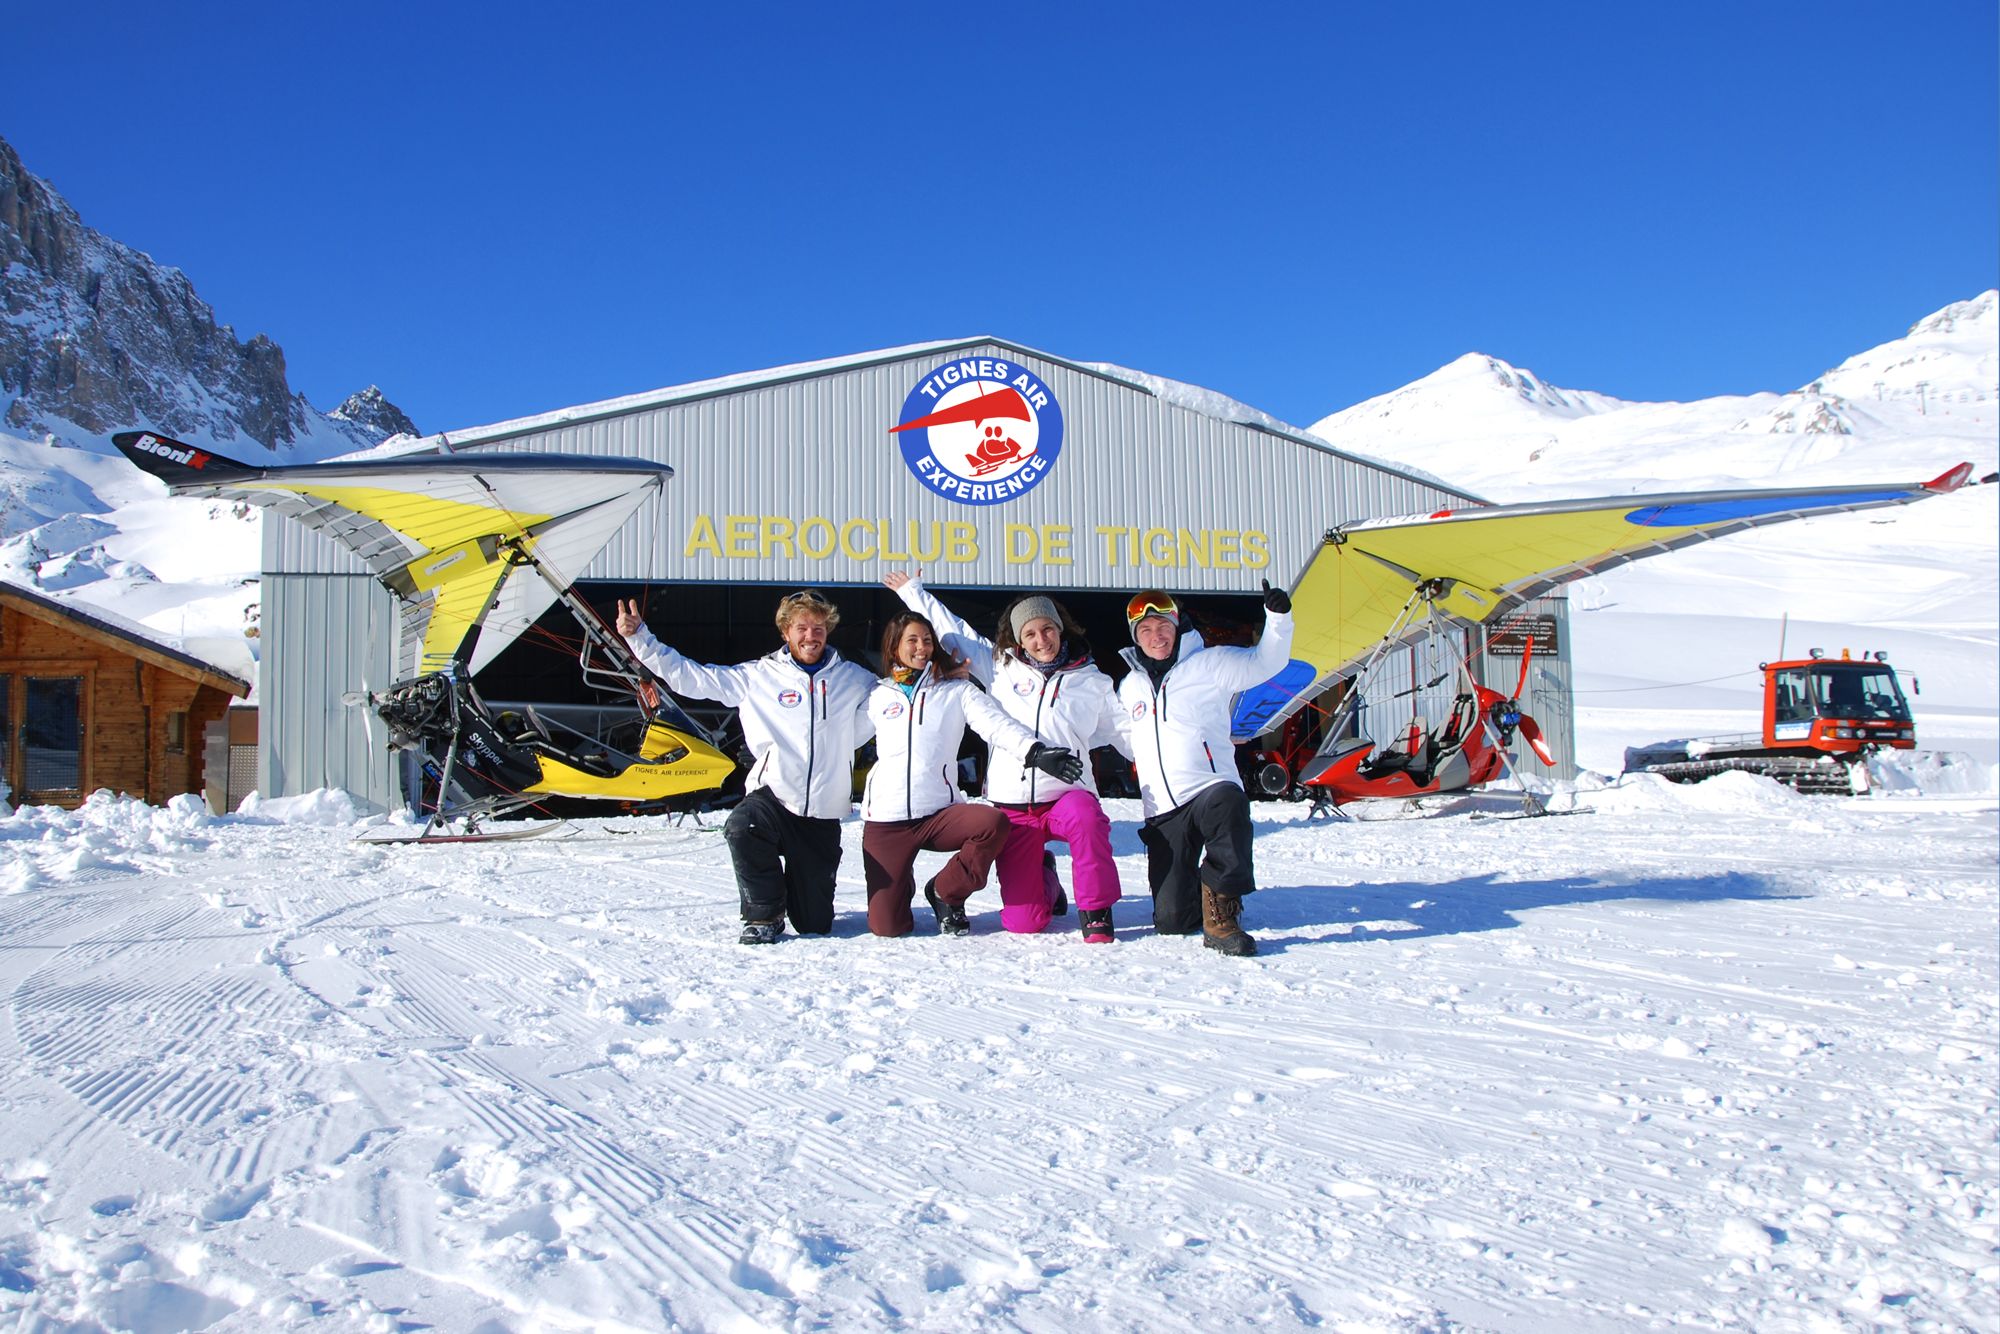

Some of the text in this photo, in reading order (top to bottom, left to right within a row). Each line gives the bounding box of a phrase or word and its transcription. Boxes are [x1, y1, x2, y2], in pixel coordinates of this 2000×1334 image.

[920, 360, 1048, 411] TIGNES AIR
[916, 454, 1047, 500] EXPERIENCE
[685, 514, 1270, 569] AEROCLUB DE TIGNES
[469, 732, 504, 766] Skypper
[635, 767, 658, 775] TIGNES
